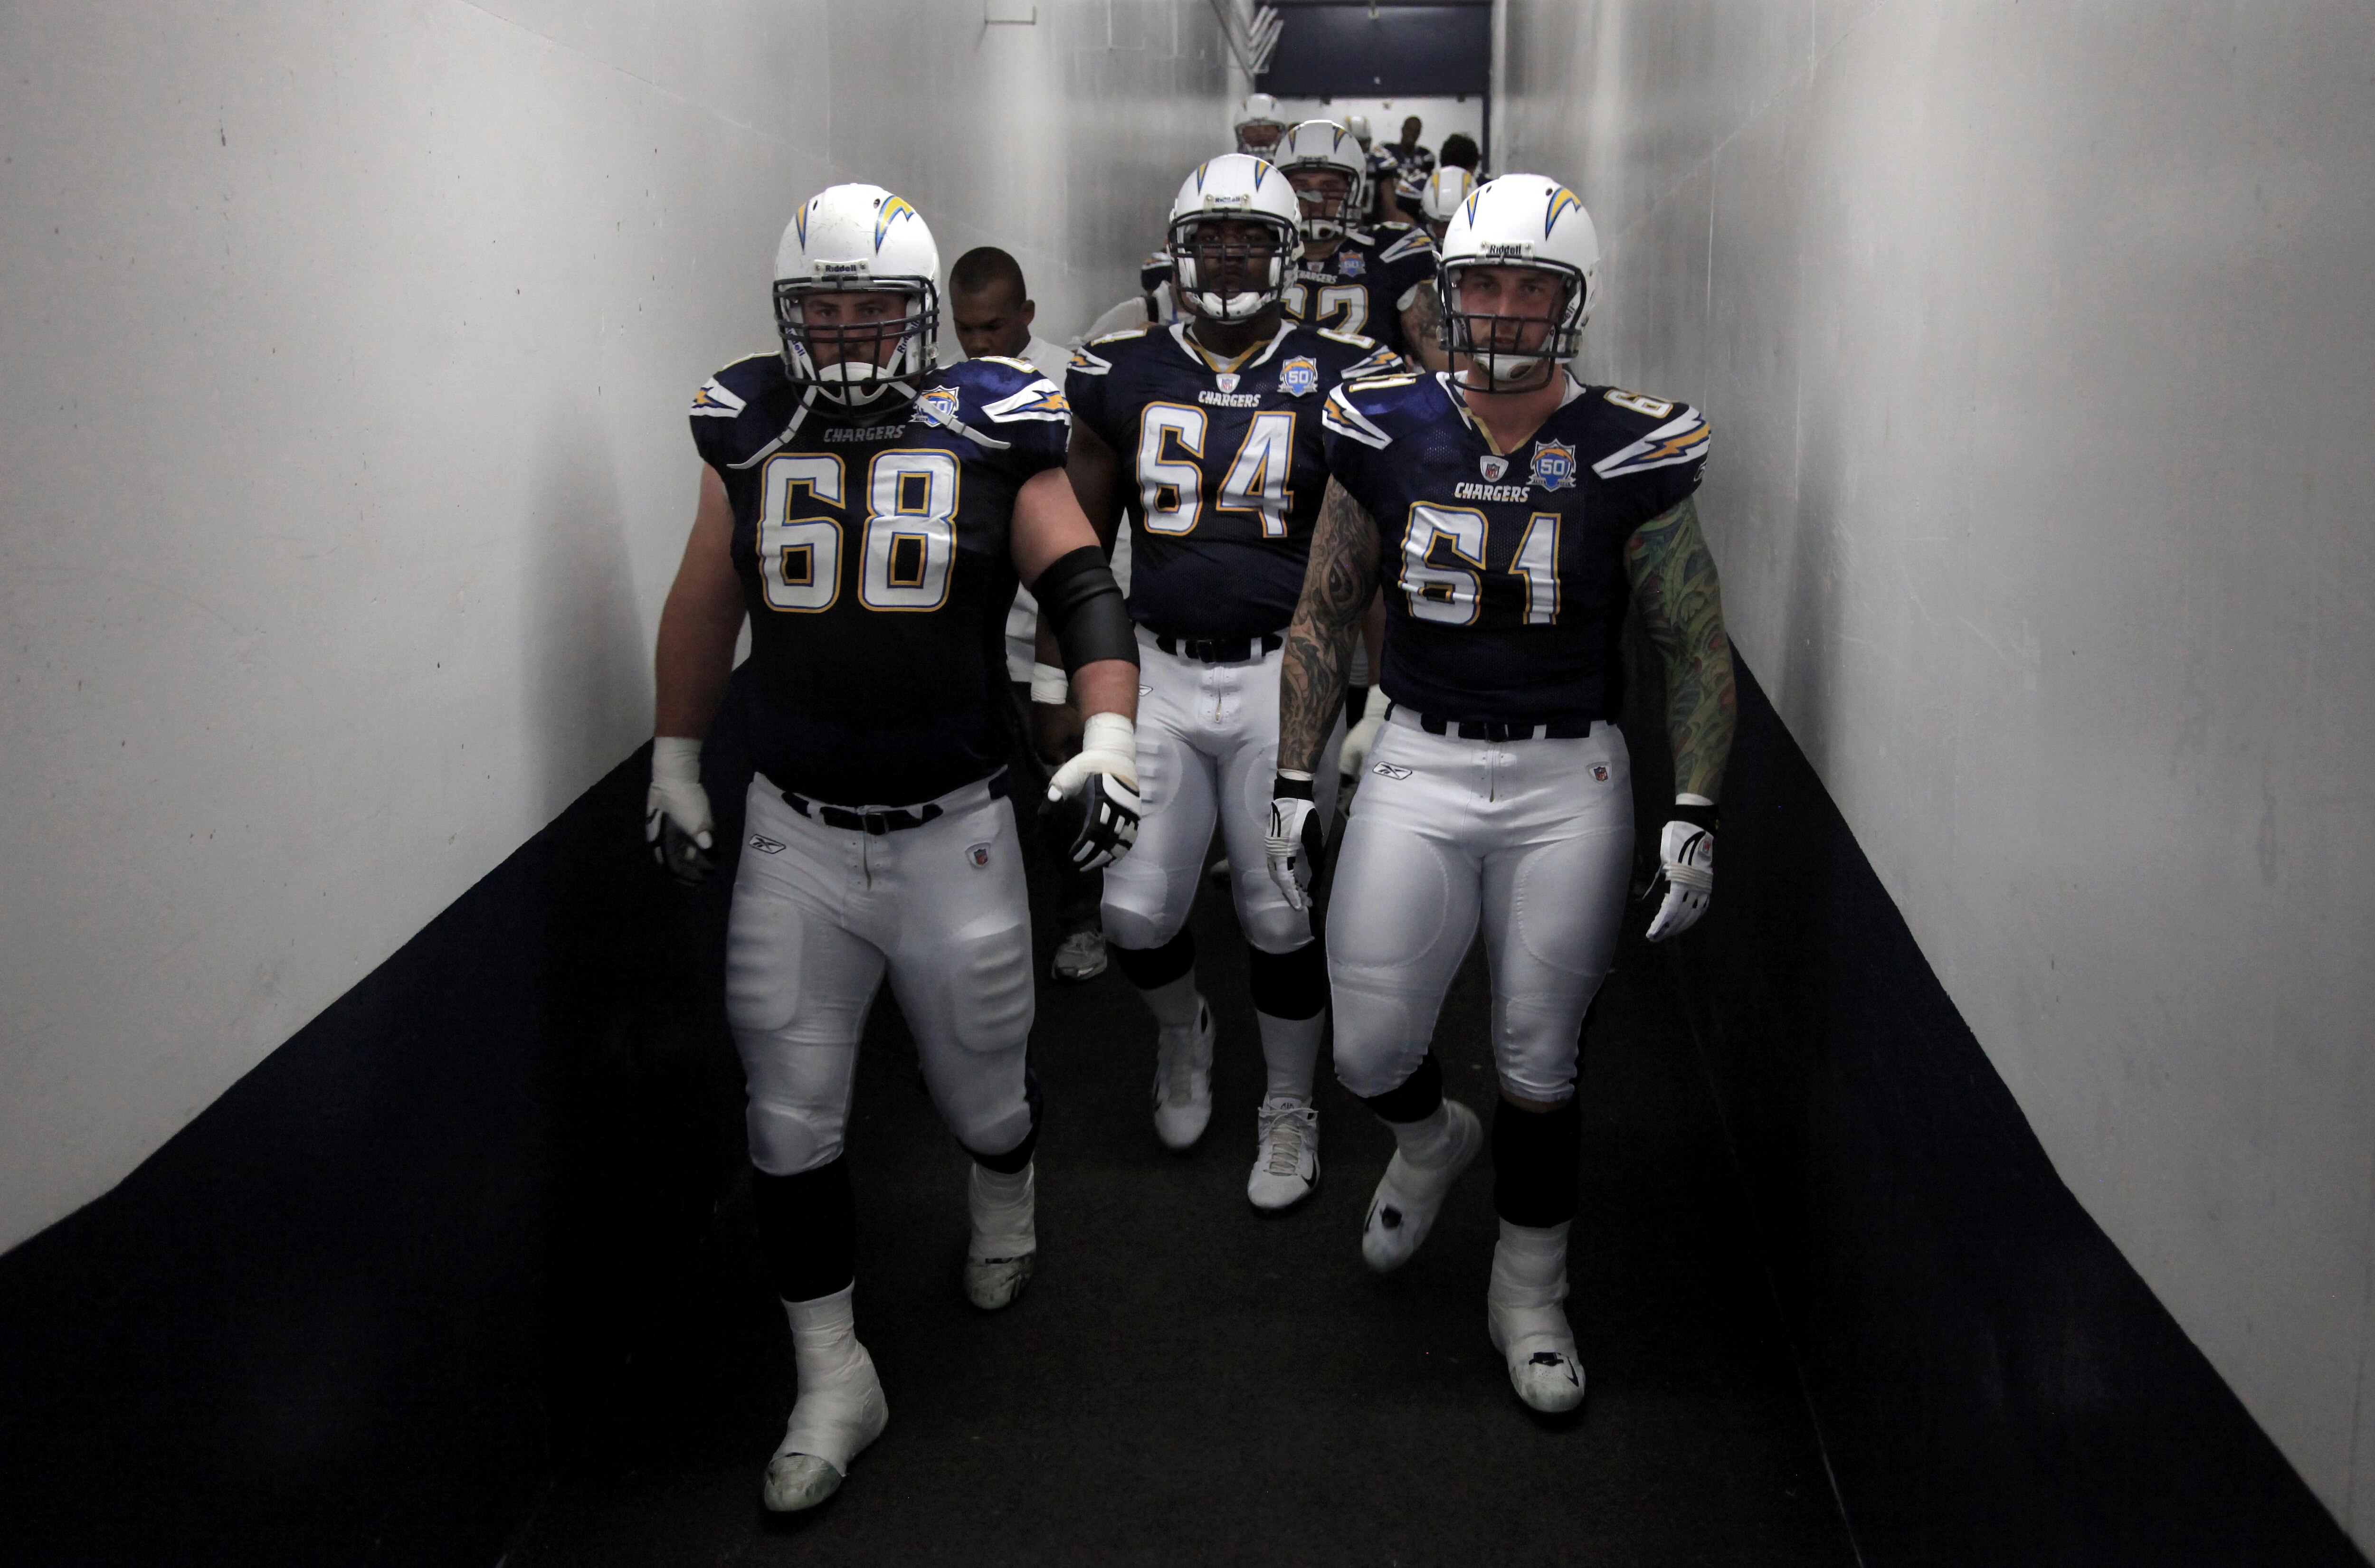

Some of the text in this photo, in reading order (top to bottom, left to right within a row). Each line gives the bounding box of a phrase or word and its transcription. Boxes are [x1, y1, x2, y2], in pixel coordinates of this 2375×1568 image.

[1490, 245, 1521, 255] Riddell
[826, 264, 857, 273] Riddell
[1289, 370, 1309, 384] 50
[1197, 390, 1261, 407] CHARGERS
[823, 425, 906, 443] CHARGERS
[1136, 401, 1296, 538] 64
[1540, 459, 1565, 476] 50
[1454, 482, 1530, 502] CHARGERS
[756, 449, 960, 613] 68
[1397, 501, 1561, 625] 61
